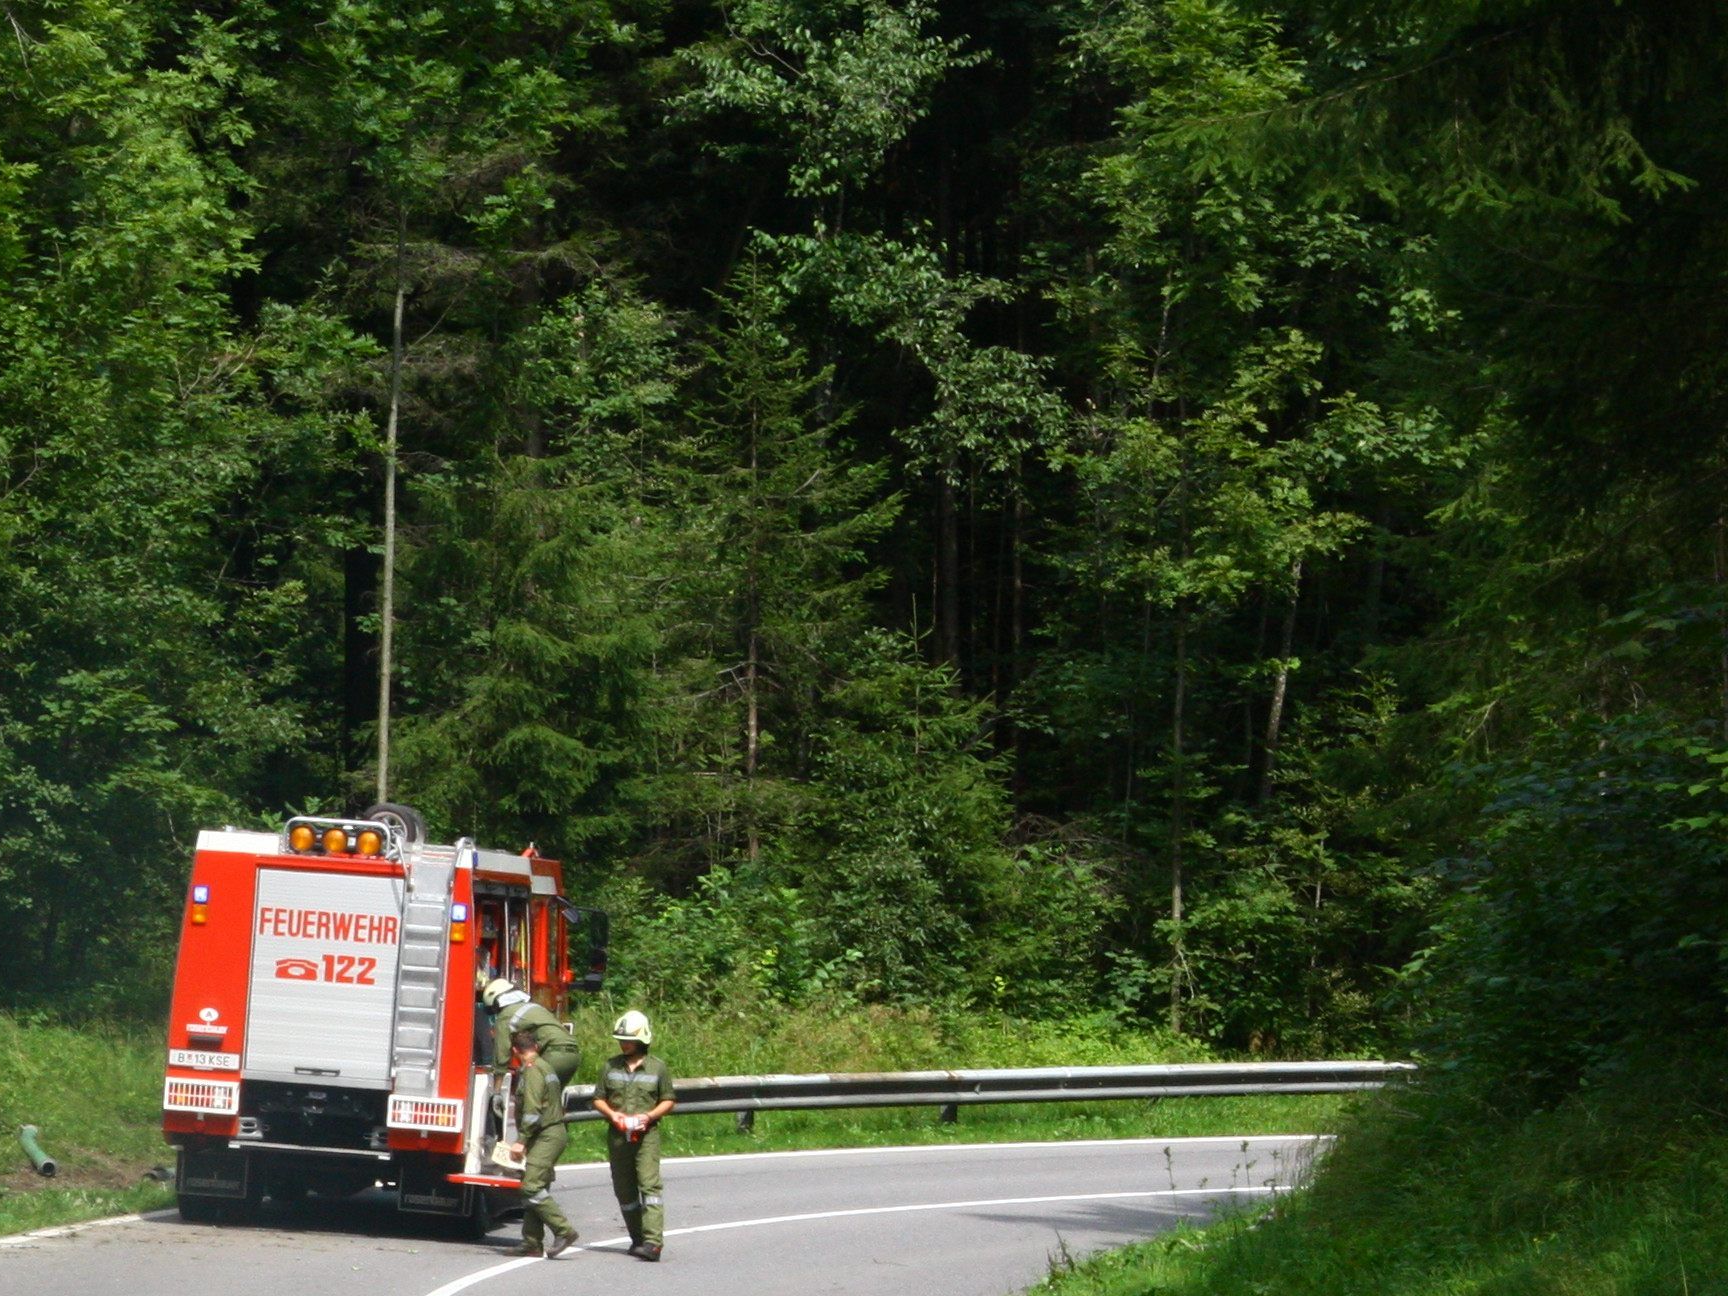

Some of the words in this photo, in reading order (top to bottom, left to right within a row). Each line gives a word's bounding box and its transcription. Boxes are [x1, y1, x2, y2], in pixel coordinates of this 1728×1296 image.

[258, 907, 398, 945] FEUERWEHR
[322, 954, 377, 985] 122
[177, 1052, 185, 1063] B
[194, 1053, 206, 1065] 13
[208, 1054, 231, 1067] KSE
